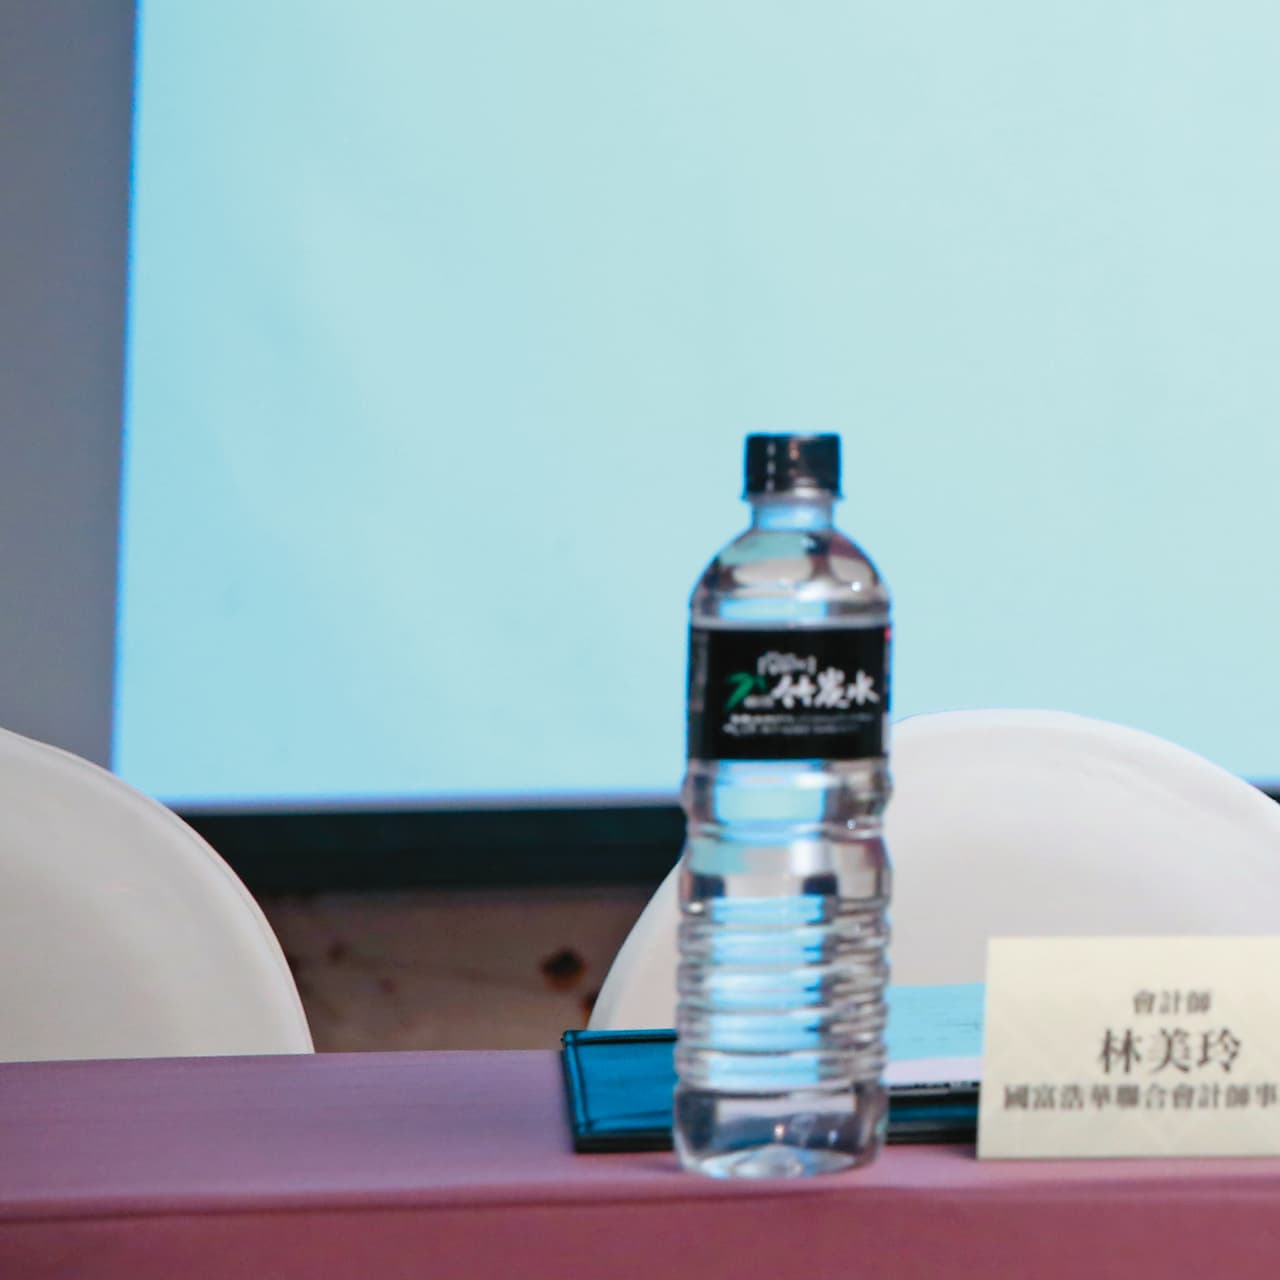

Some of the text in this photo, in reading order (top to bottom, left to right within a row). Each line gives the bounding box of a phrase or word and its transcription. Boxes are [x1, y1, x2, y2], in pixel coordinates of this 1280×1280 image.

[1133, 989, 1213, 1016] 會計師
[1097, 1027, 1242, 1075] 林美玲
